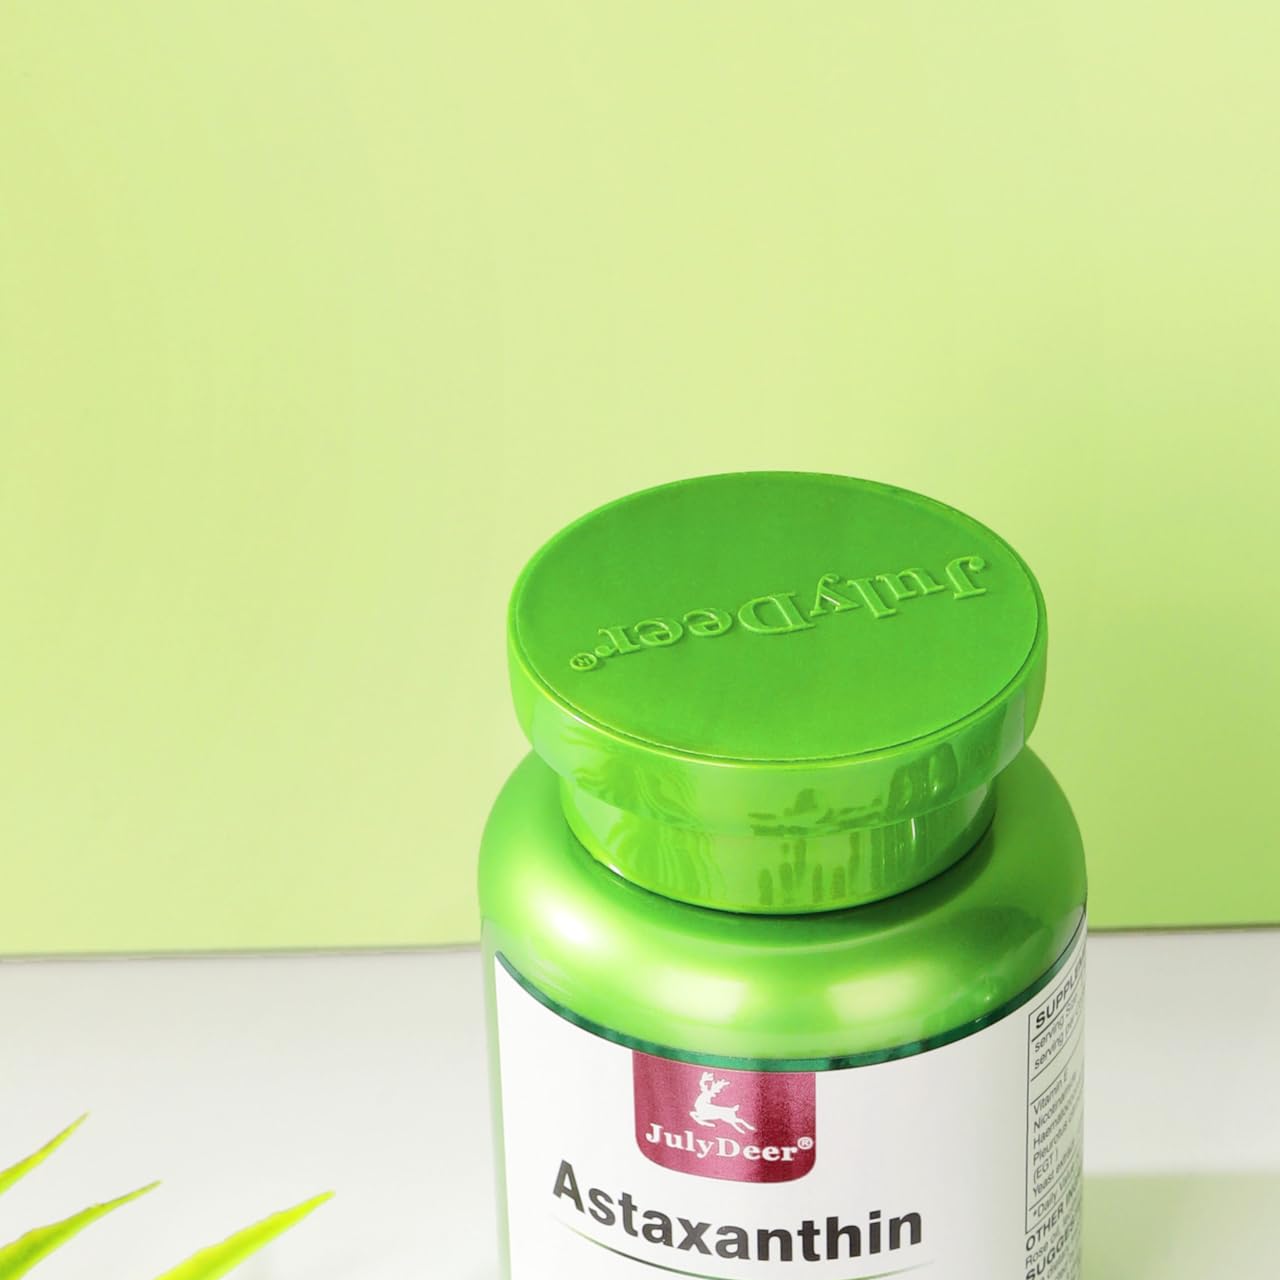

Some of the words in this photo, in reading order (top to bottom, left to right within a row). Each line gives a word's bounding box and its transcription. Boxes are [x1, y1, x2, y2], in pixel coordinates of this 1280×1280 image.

[552, 1160, 922, 1262] Astaxanthin
[1025, 1201, 1064, 1251] OTHER
[1025, 1241, 1049, 1269] Rose
